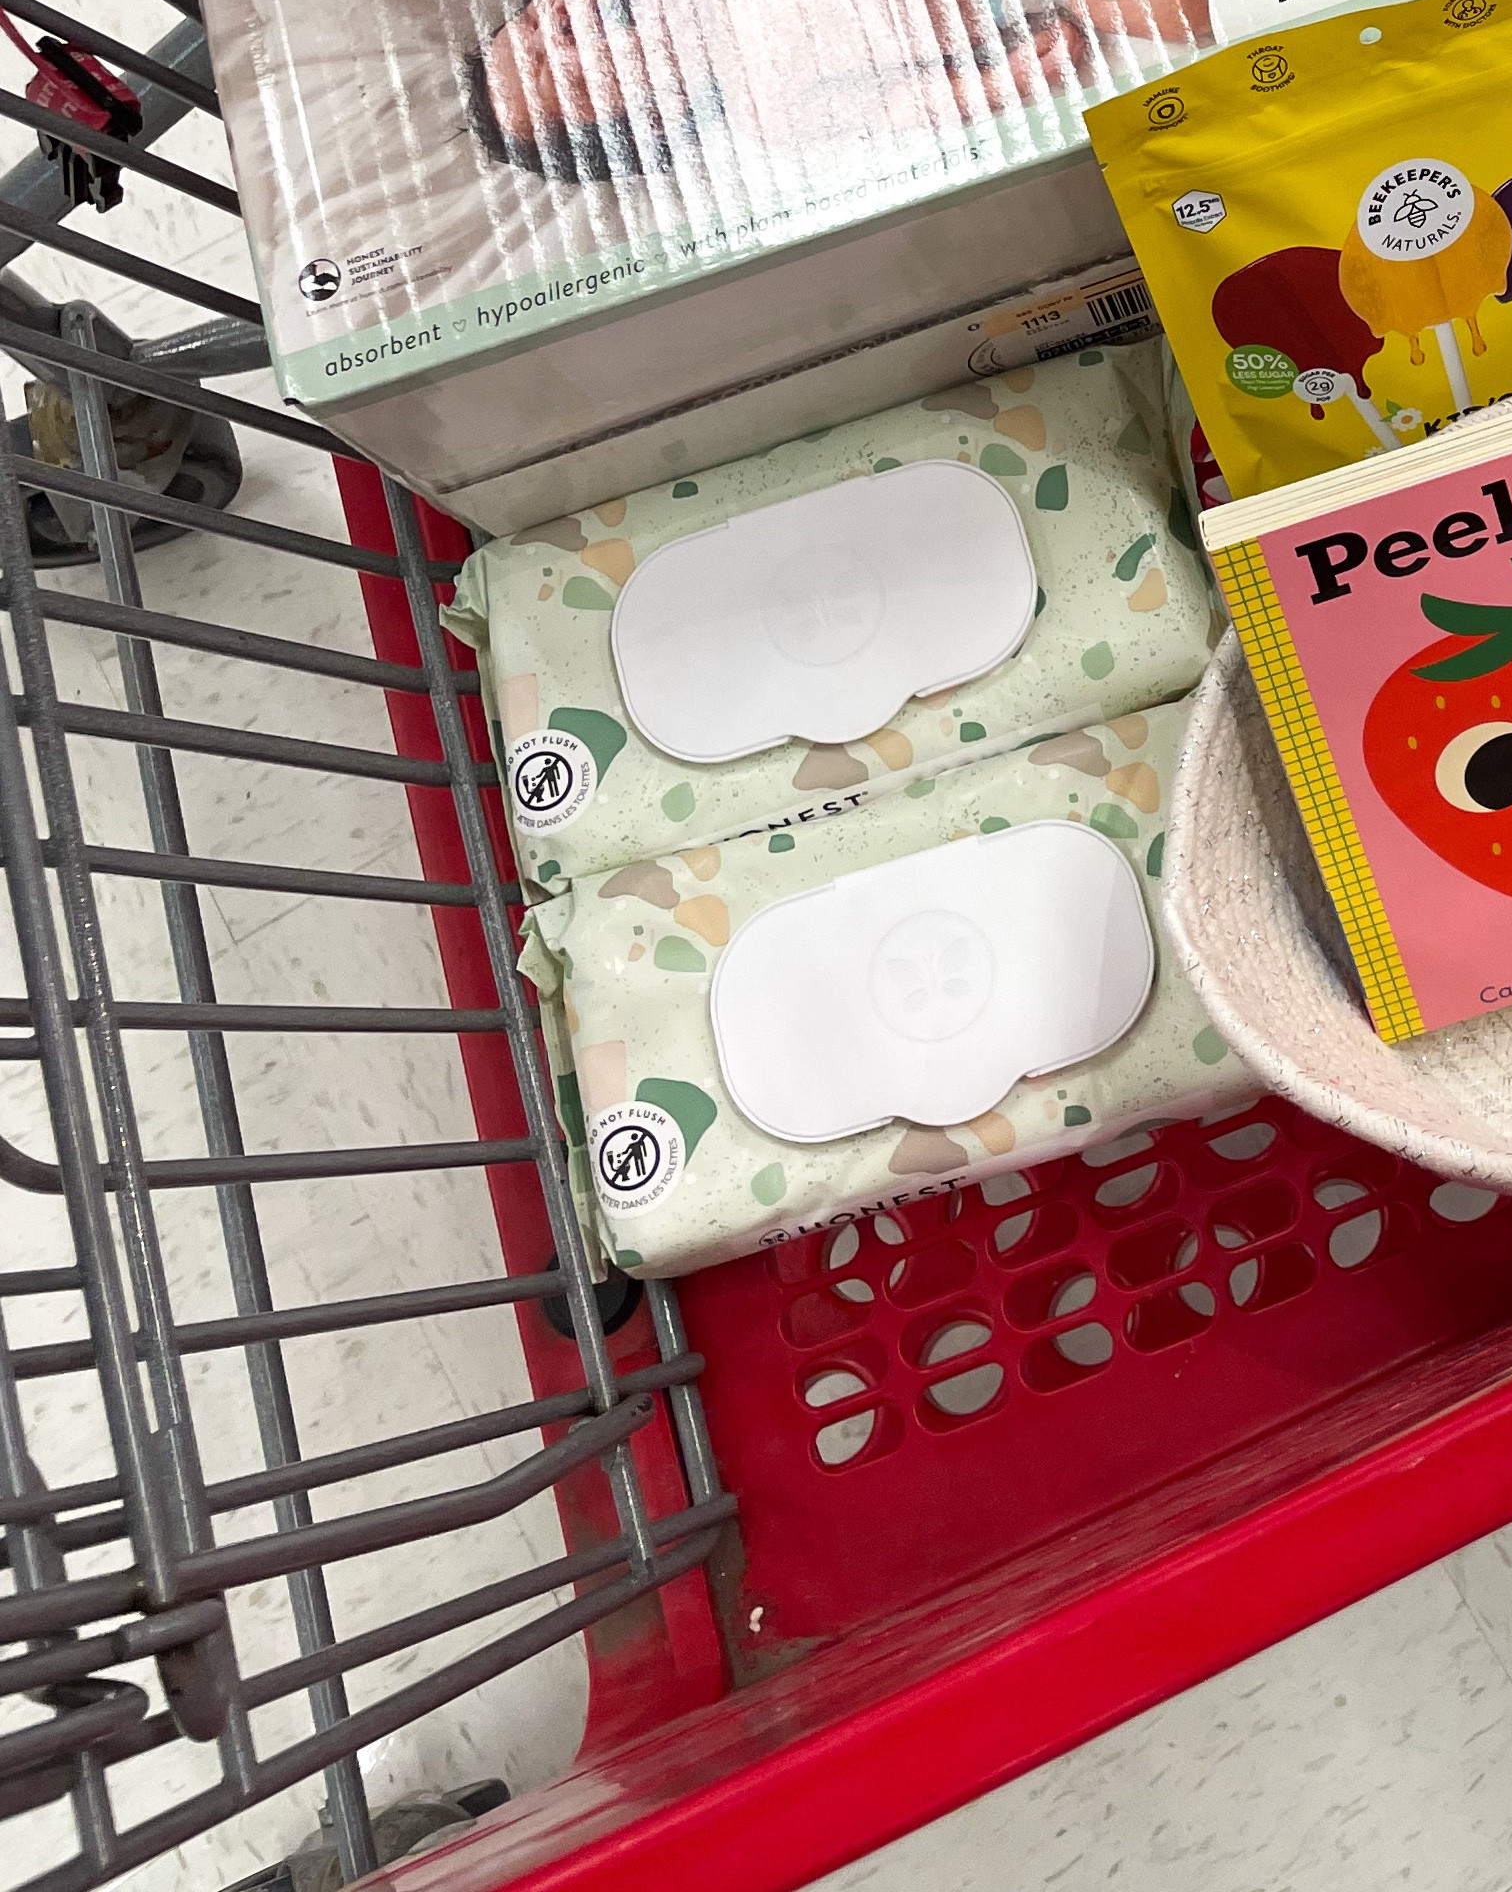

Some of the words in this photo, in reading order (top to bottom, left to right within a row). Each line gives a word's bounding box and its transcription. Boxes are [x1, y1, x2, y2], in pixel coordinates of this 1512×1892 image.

[1246, 45, 1285, 61] THROAT
[1368, 168, 1462, 227] BEEKEEPER'S
[346, 247, 385, 266] HONEST
[351, 265, 395, 286] JOURNEY
[325, 323, 442, 377] absorbent
[477, 257, 646, 327] hypoallergenic
[1232, 353, 1289, 370] 50%
[514, 738, 537, 755] NOT
[542, 736, 578, 751] FLUSH
[599, 1110, 623, 1128] NOT
[628, 1108, 667, 1126] FLUSH
